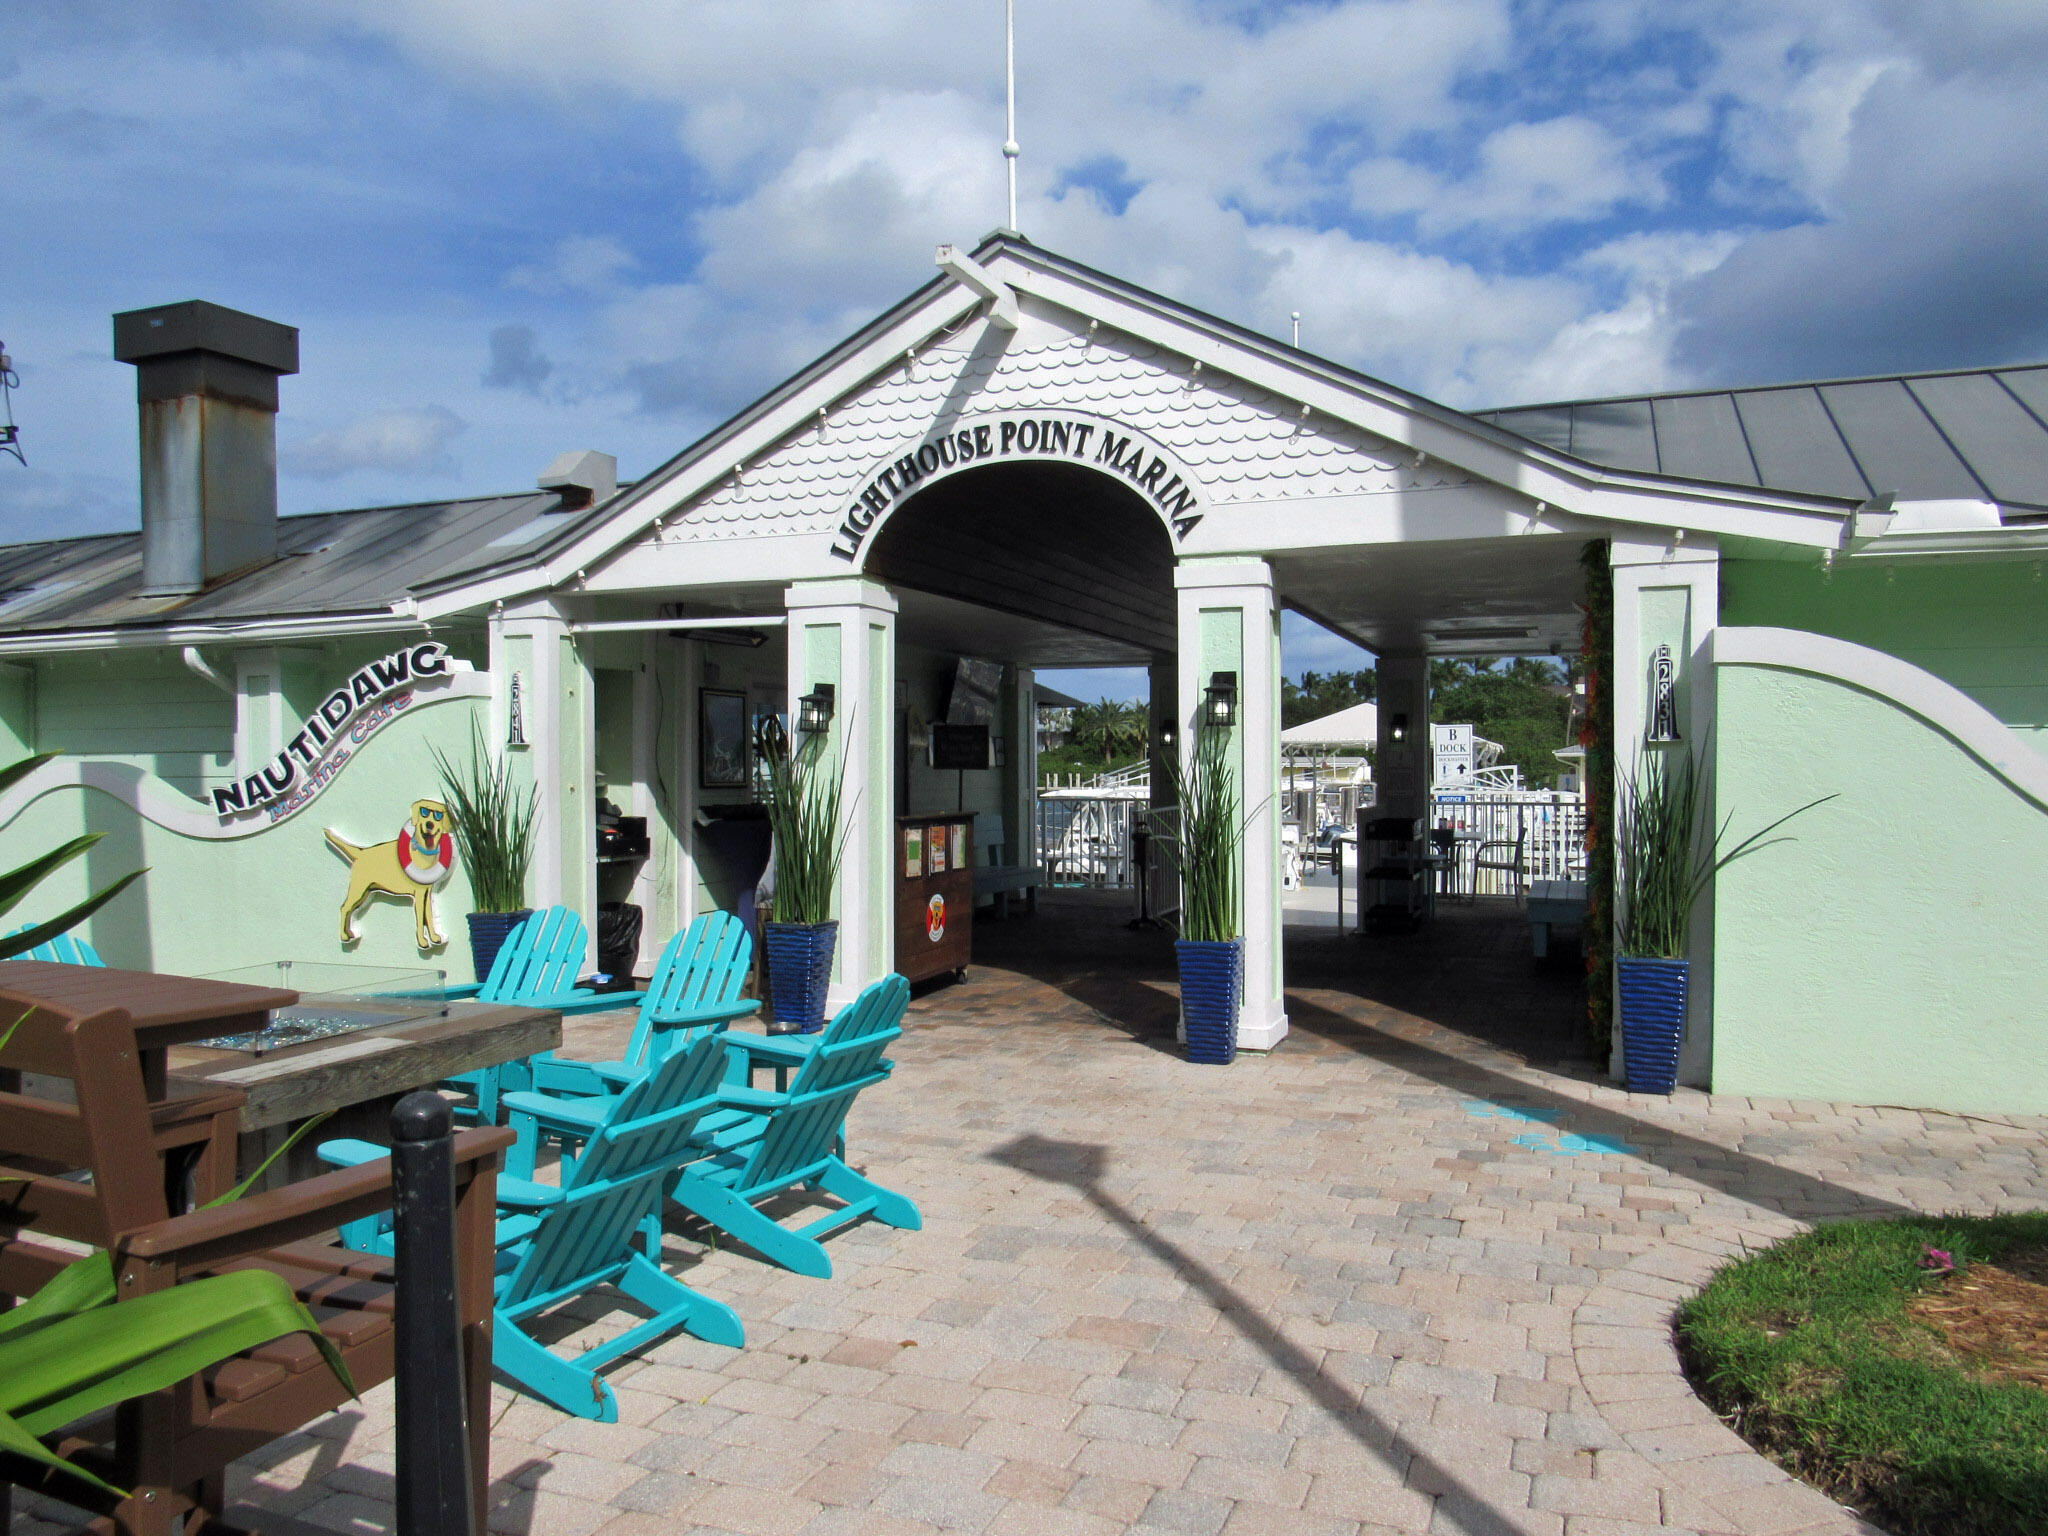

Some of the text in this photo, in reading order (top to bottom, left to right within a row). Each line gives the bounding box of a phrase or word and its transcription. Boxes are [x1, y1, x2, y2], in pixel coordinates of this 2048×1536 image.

[830, 419, 1205, 564] LIGHTHOUSE POINT MARINA
[212, 643, 448, 816] NAUTIDAWG
[1449, 728, 1457, 741] B
[1659, 664, 1670, 739] 2831
[269, 748, 351, 822] Marina
[1439, 744, 1466, 752] DOCK
